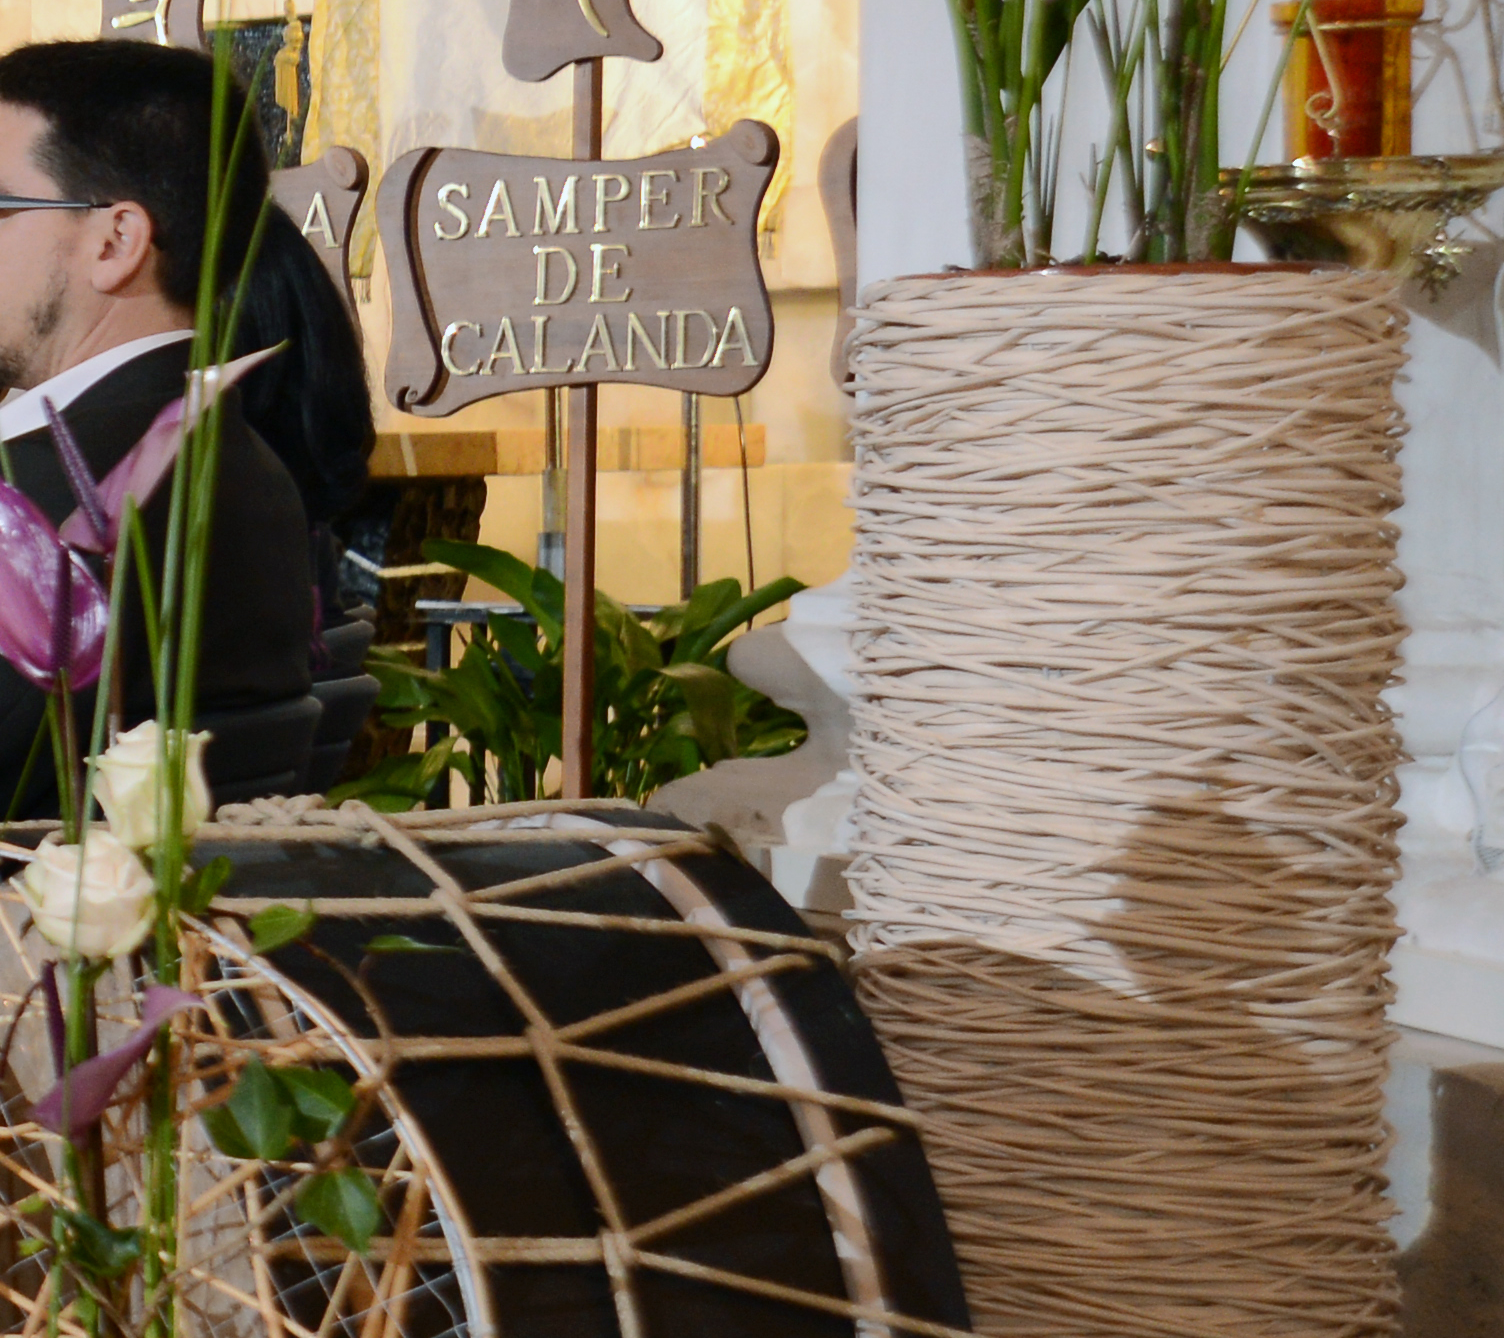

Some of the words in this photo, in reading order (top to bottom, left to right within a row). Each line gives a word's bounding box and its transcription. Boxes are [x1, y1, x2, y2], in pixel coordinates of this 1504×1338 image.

[434, 167, 734, 241] SAMPER
[532, 243, 633, 306] DE
[441, 306, 762, 378] CALANDA
